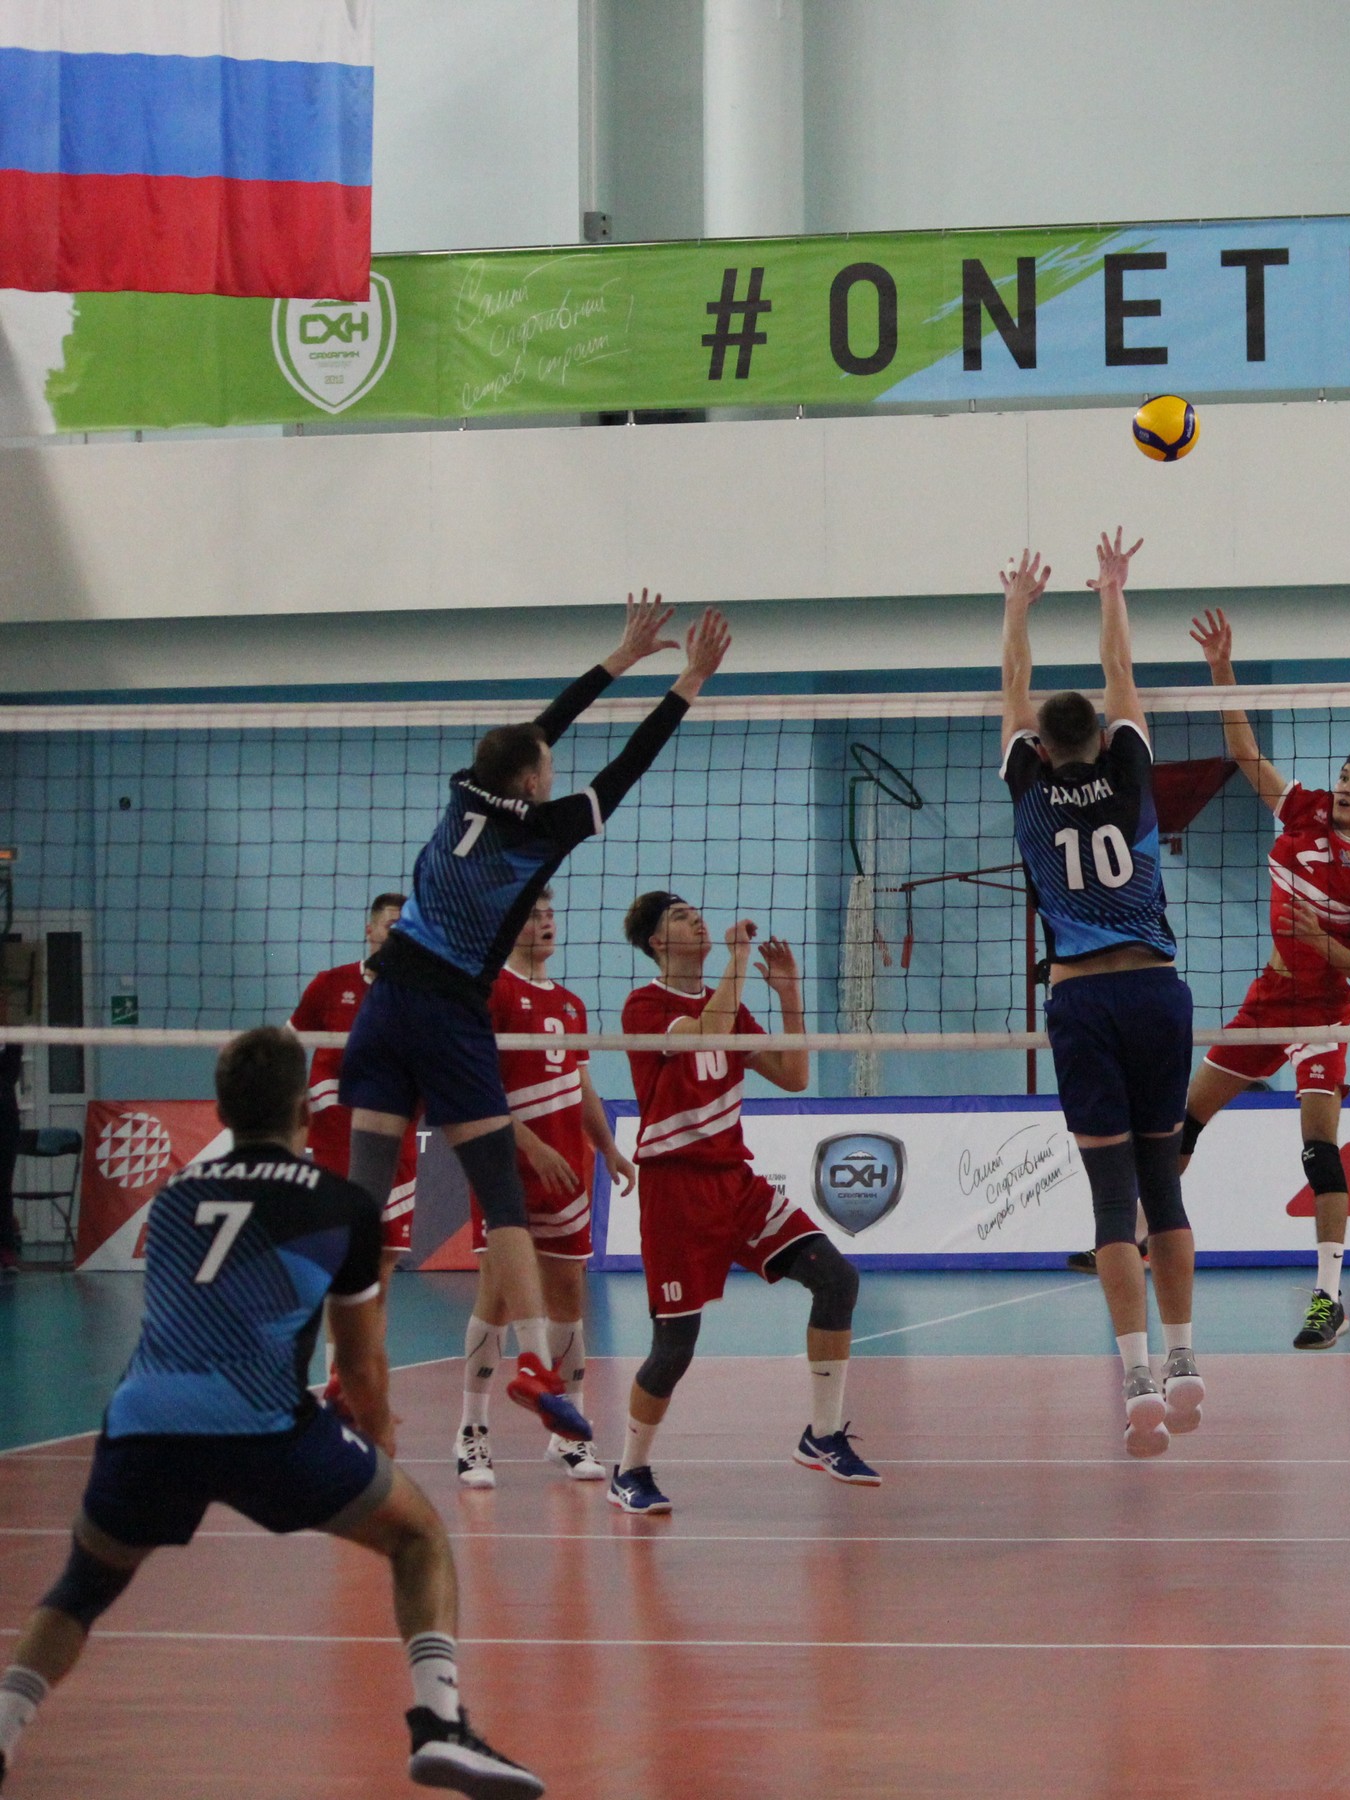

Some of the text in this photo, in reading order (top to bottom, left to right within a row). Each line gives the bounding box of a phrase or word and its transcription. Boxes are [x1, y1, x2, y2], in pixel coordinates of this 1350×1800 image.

[1043, 777, 1114, 808] АХАЛИН
[452, 811, 487, 858] 7
[1054, 823, 1134, 890] 10
[194, 1200, 254, 1284] 7
[661, 1280, 682, 1302] 10
